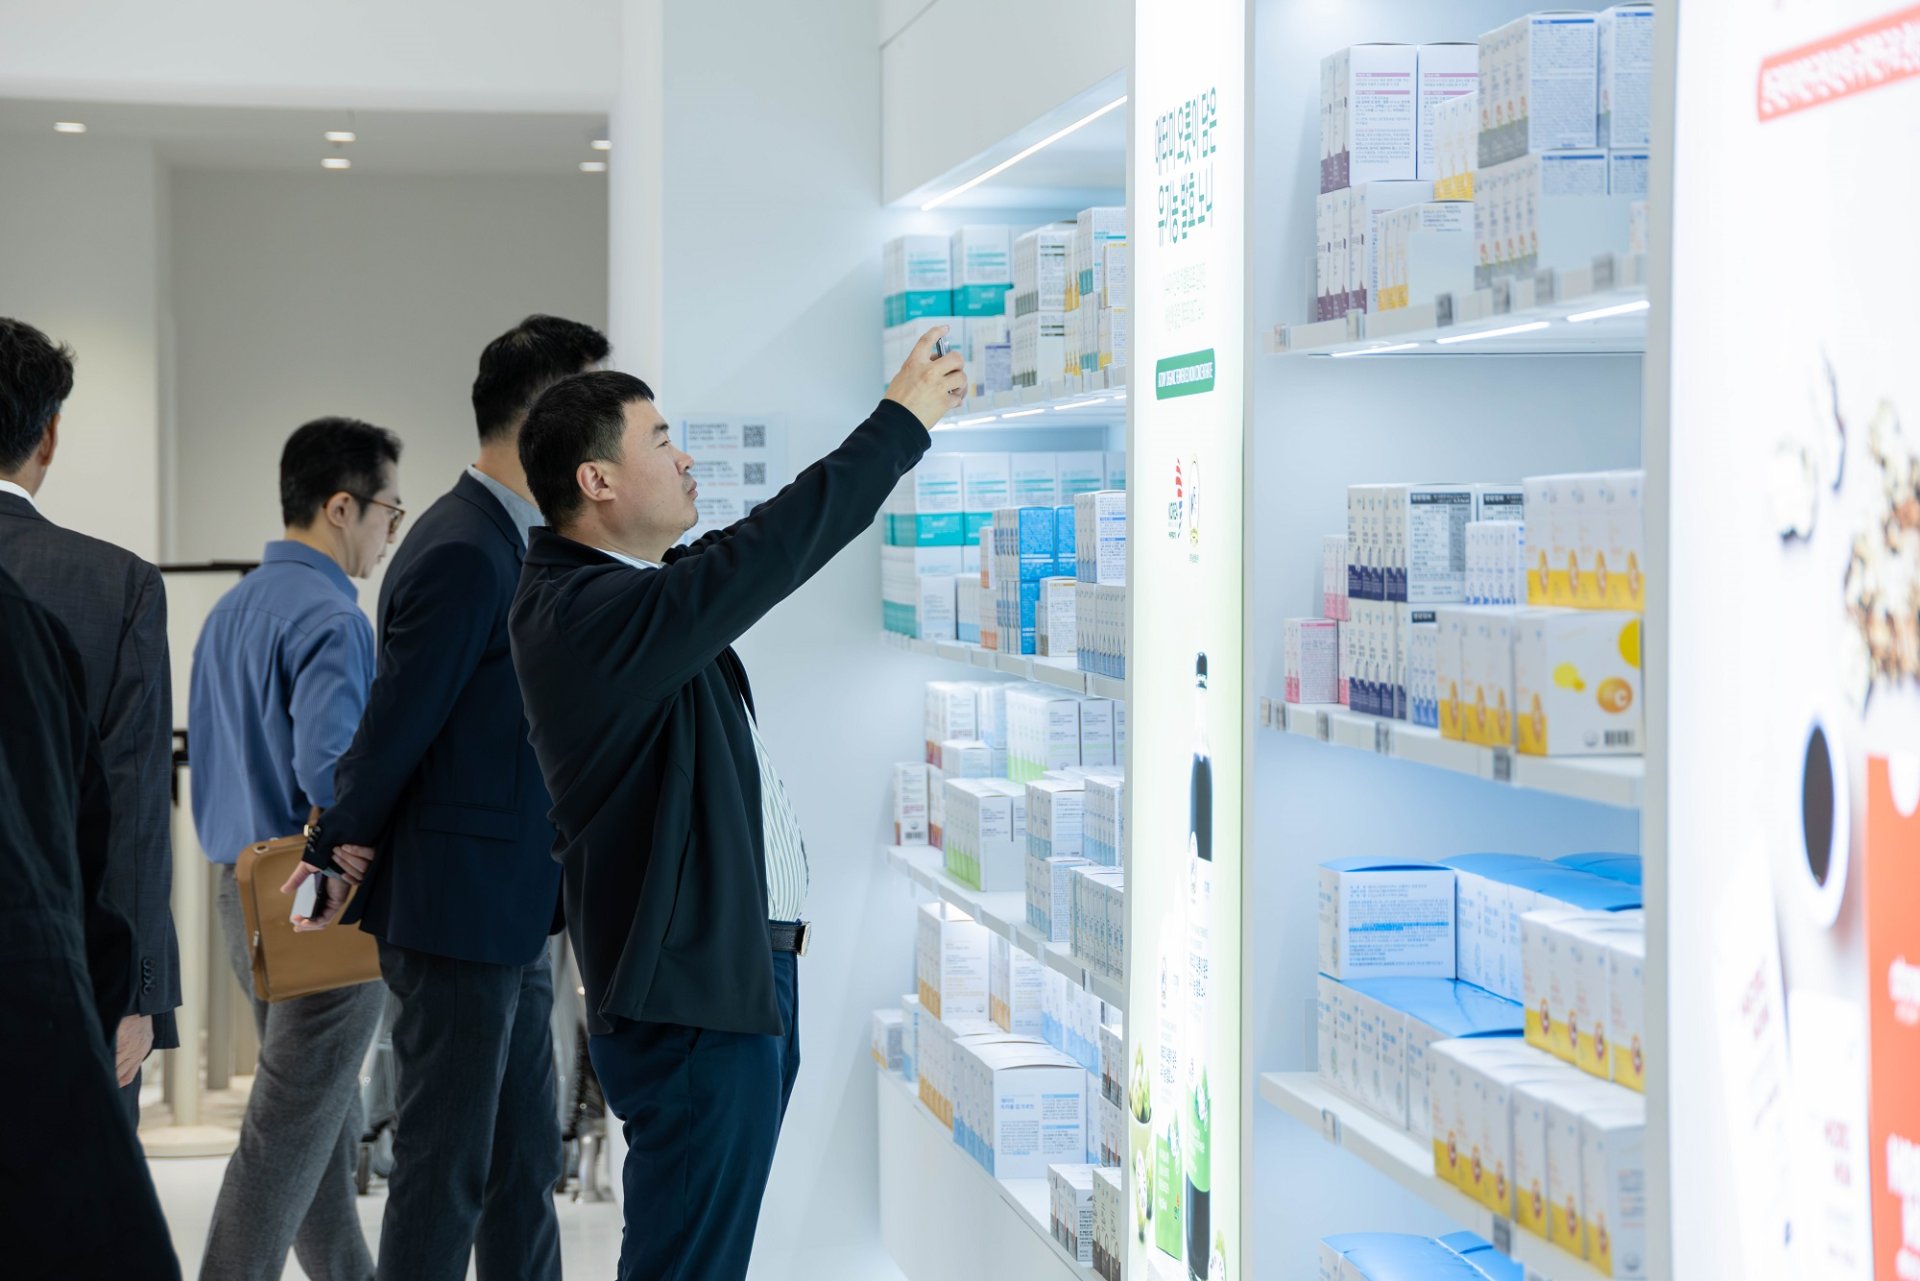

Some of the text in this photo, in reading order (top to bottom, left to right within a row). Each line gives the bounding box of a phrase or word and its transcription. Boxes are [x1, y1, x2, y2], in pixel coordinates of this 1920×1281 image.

[1178, 97, 1199, 163] 오롯이
[1202, 88, 1217, 157] 담은
[1158, 164, 1213, 246] 유기농 발효 노니
